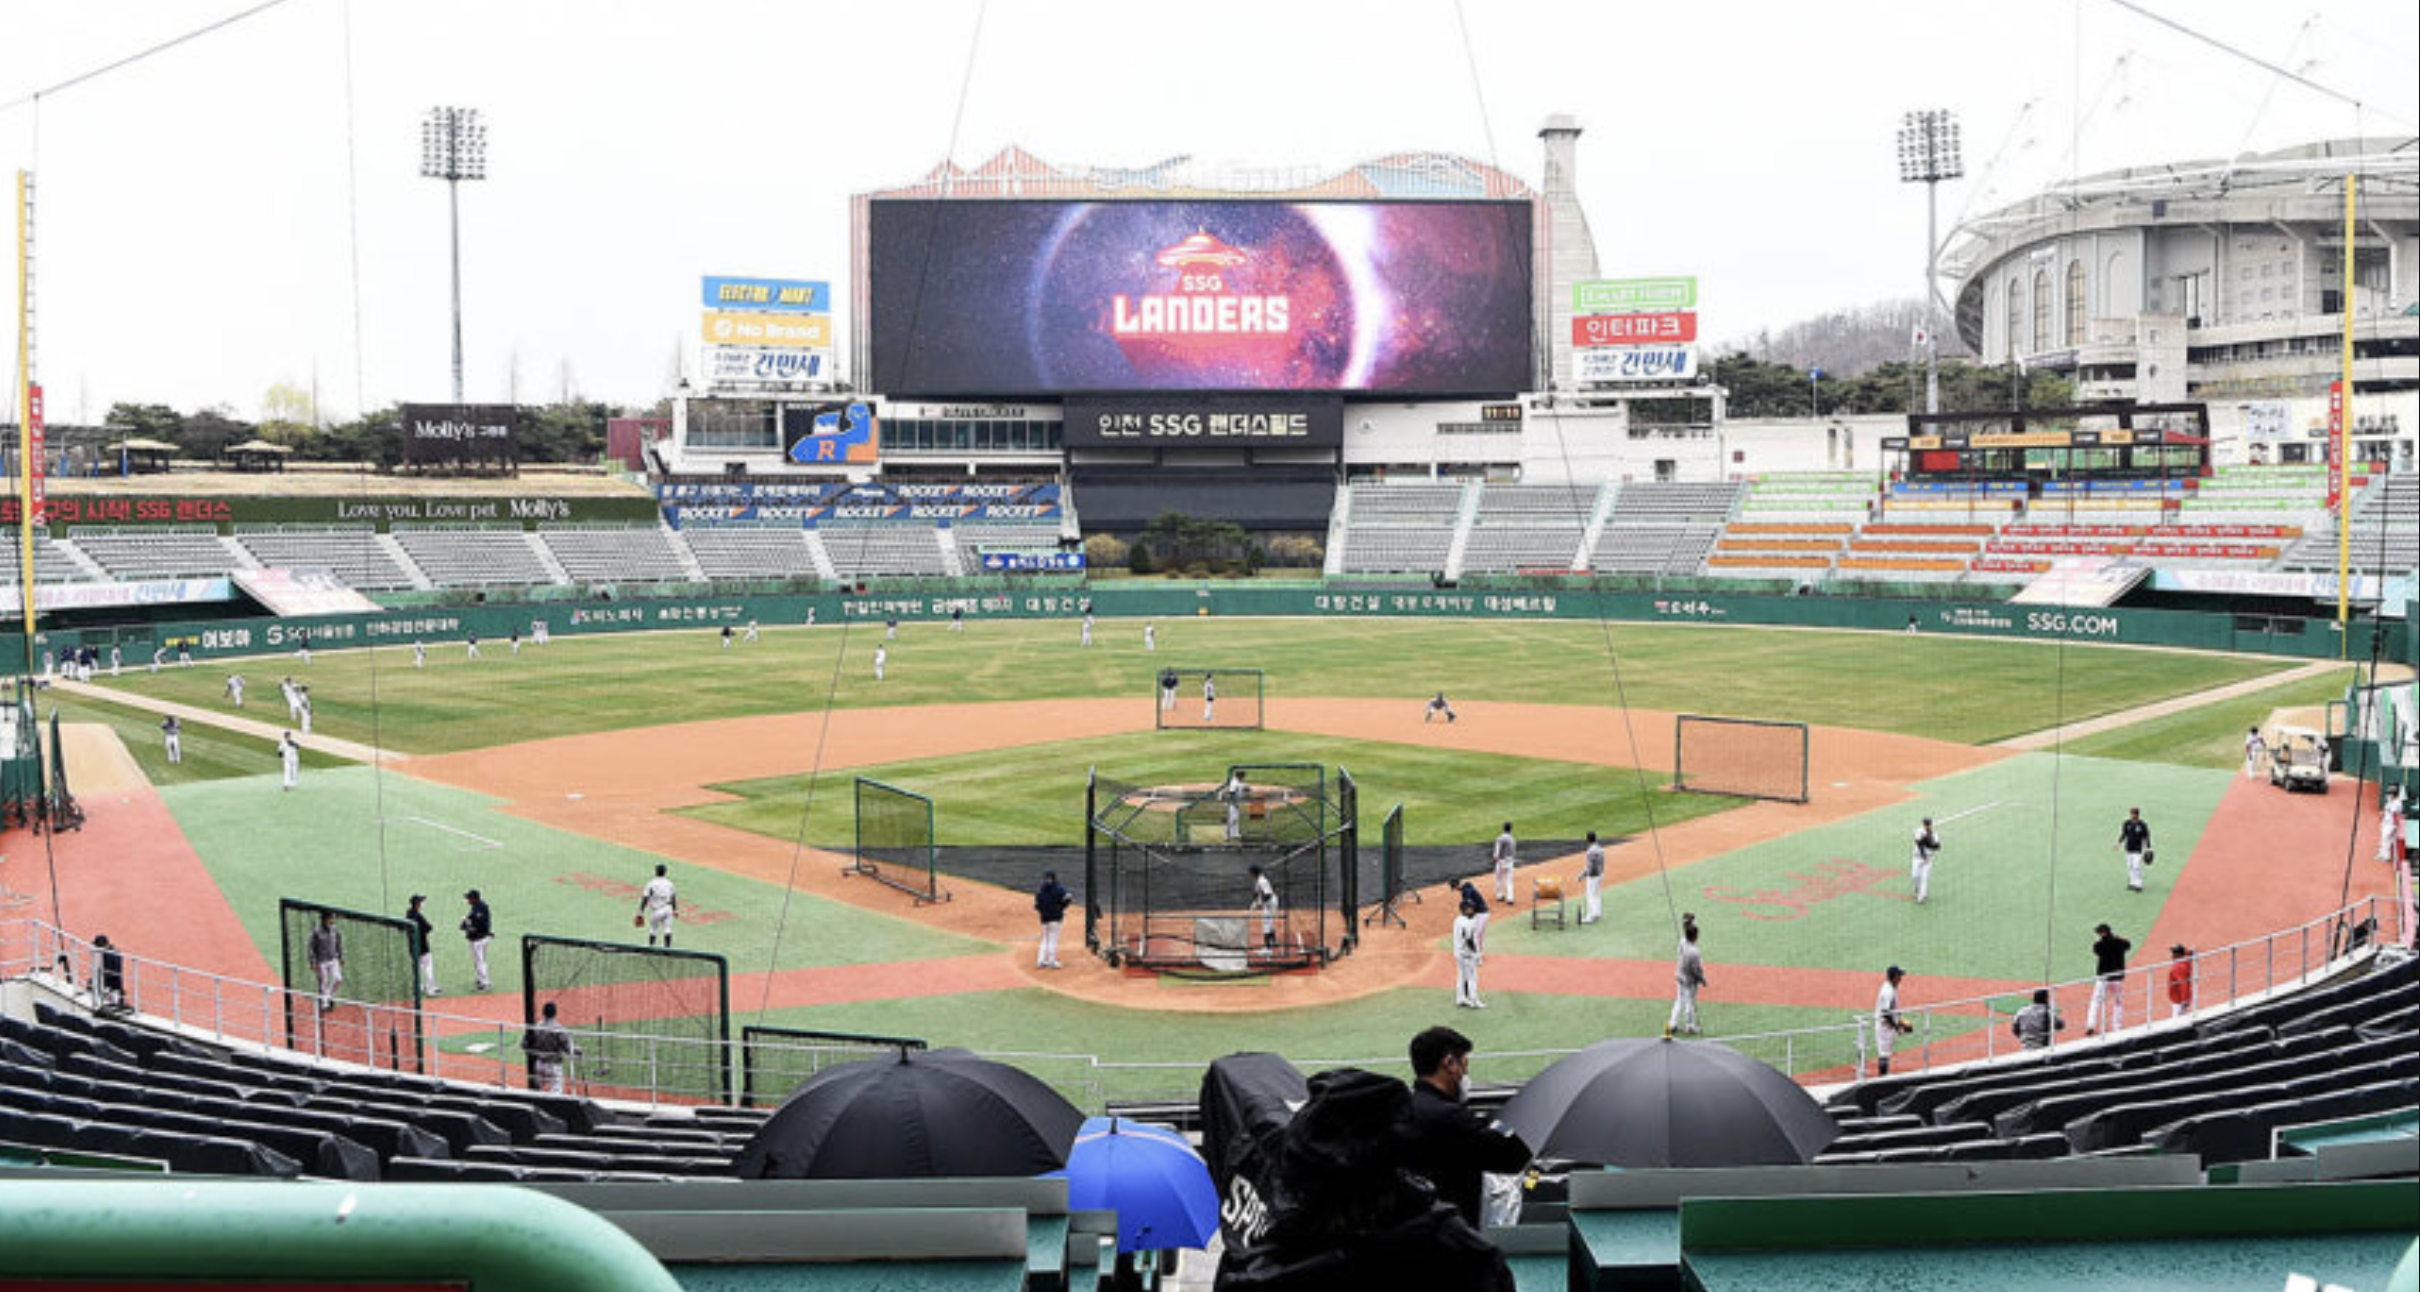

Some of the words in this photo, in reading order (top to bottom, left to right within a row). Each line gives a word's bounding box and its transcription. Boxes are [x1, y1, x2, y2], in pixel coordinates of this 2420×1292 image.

[1183, 275, 1222, 292] SSG
[1113, 295, 1289, 332] LANDERS
[1585, 318, 1681, 342] 인터파크
[413, 419, 475, 441] Molly's
[1099, 413, 1142, 436] 인천
[1149, 414, 1203, 436] SSG
[1208, 413, 1308, 436] 랜더스필드
[817, 440, 835, 460] R
[86, 499, 131, 521] 시작!
[136, 500, 171, 520] SSG
[176, 499, 232, 521] 랜더스
[337, 501, 380, 518] Love
[426, 501, 466, 518] Love
[470, 501, 498, 520] pet
[510, 498, 571, 520] Molly's
[1314, 596, 1382, 611] 대방건설
[2026, 611, 2118, 636] SSG.COM
[201, 628, 251, 649] 여보야
